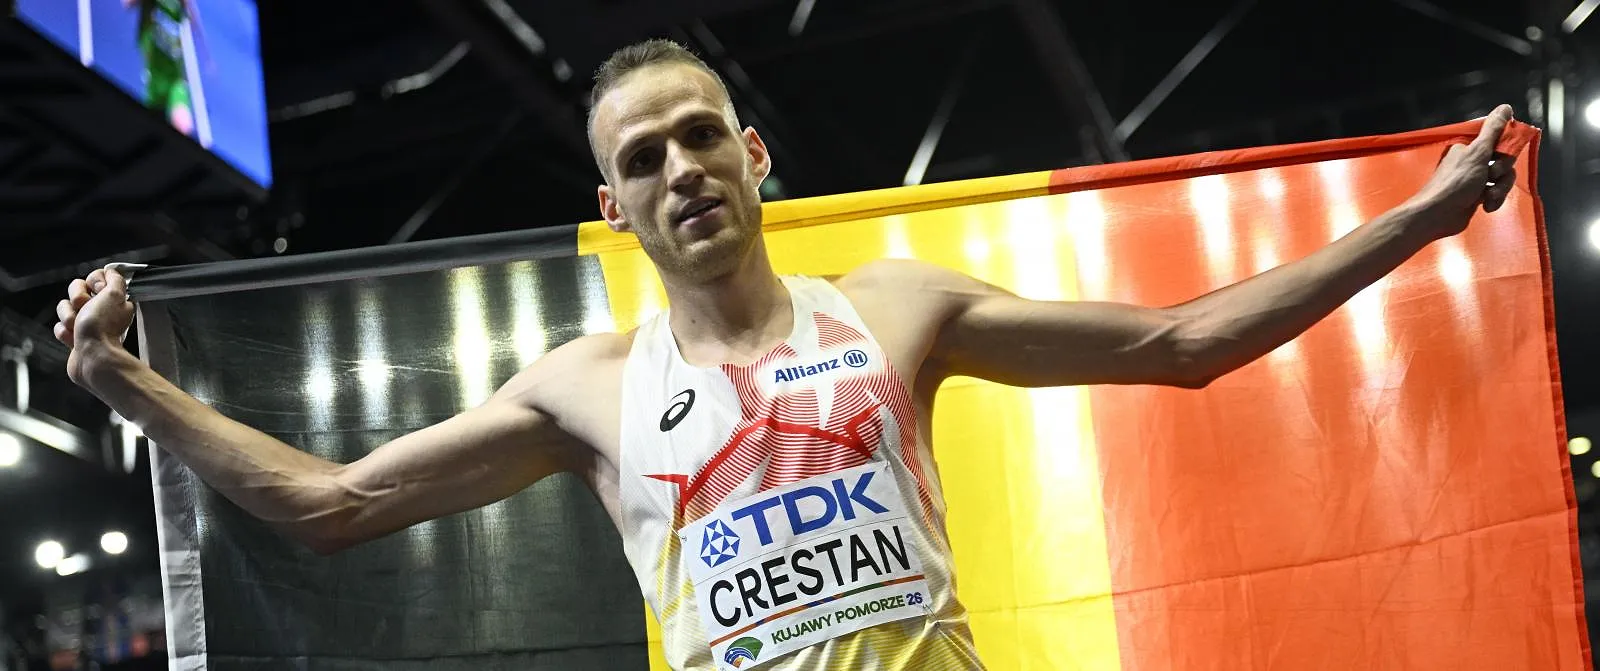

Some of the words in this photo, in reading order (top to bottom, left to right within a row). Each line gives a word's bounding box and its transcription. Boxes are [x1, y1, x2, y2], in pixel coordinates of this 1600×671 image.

[774, 357, 841, 384] Allianz
[731, 471, 890, 547] TDK
[709, 525, 911, 628] CRESTAN
[771, 613, 832, 645] KUJAWY
[835, 594, 905, 624] POMORZE
[906, 591, 924, 606] 26
